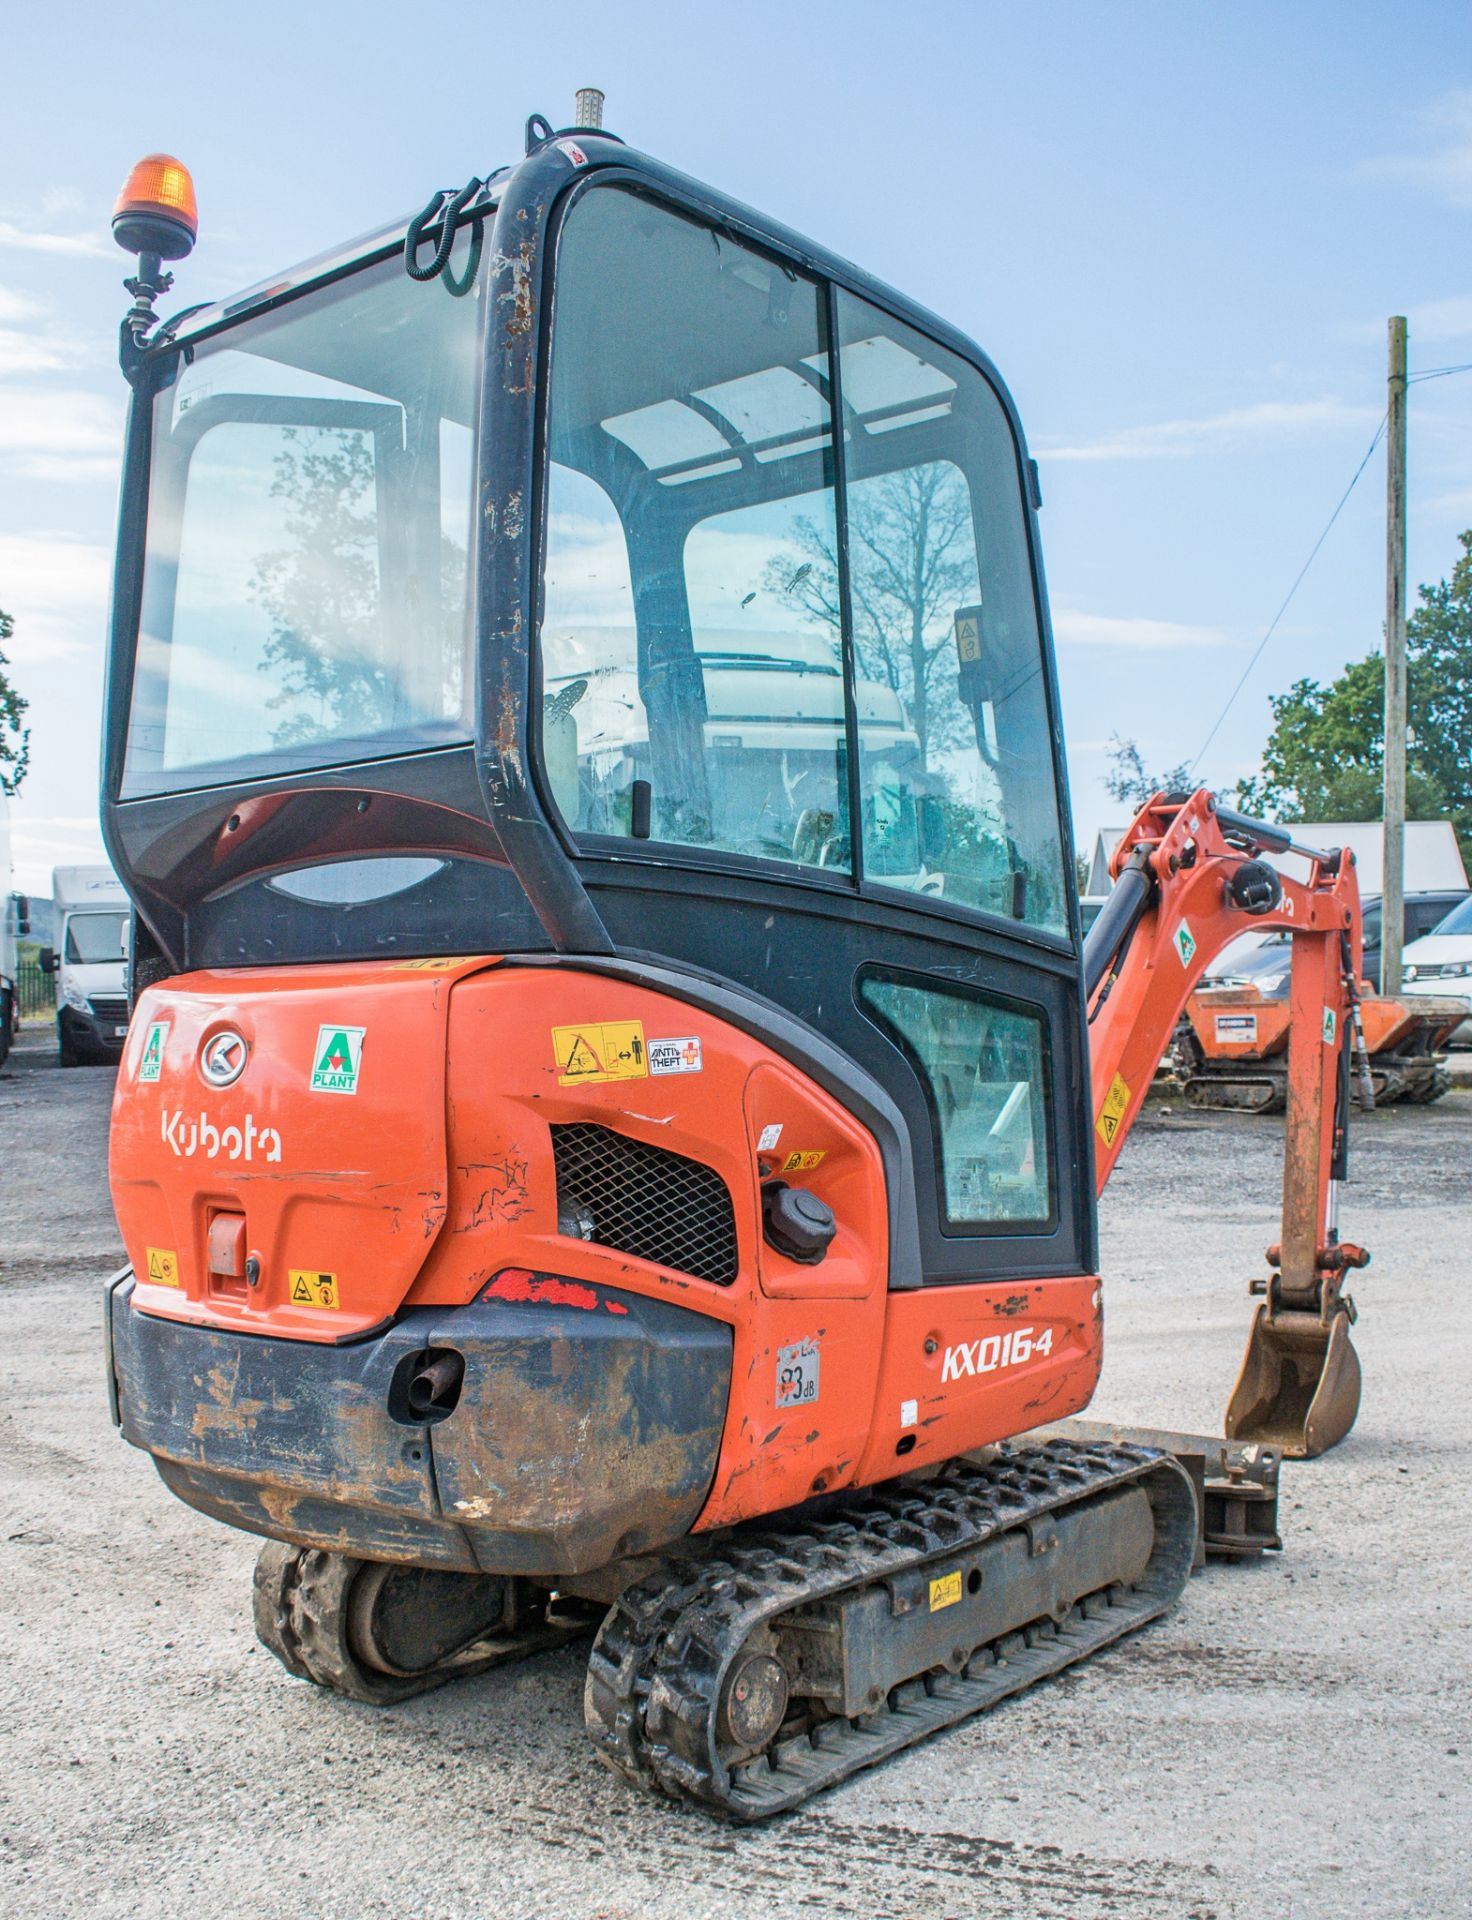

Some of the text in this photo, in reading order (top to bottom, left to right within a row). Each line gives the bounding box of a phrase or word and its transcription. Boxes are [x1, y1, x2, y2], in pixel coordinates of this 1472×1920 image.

[144, 1028, 160, 1062] A
[318, 1032, 353, 1072] A
[651, 1057, 680, 1067] THEFT
[313, 1073, 355, 1088] PLANT
[161, 1109, 282, 1162] Kubota
[803, 1380, 815, 1397] dB
